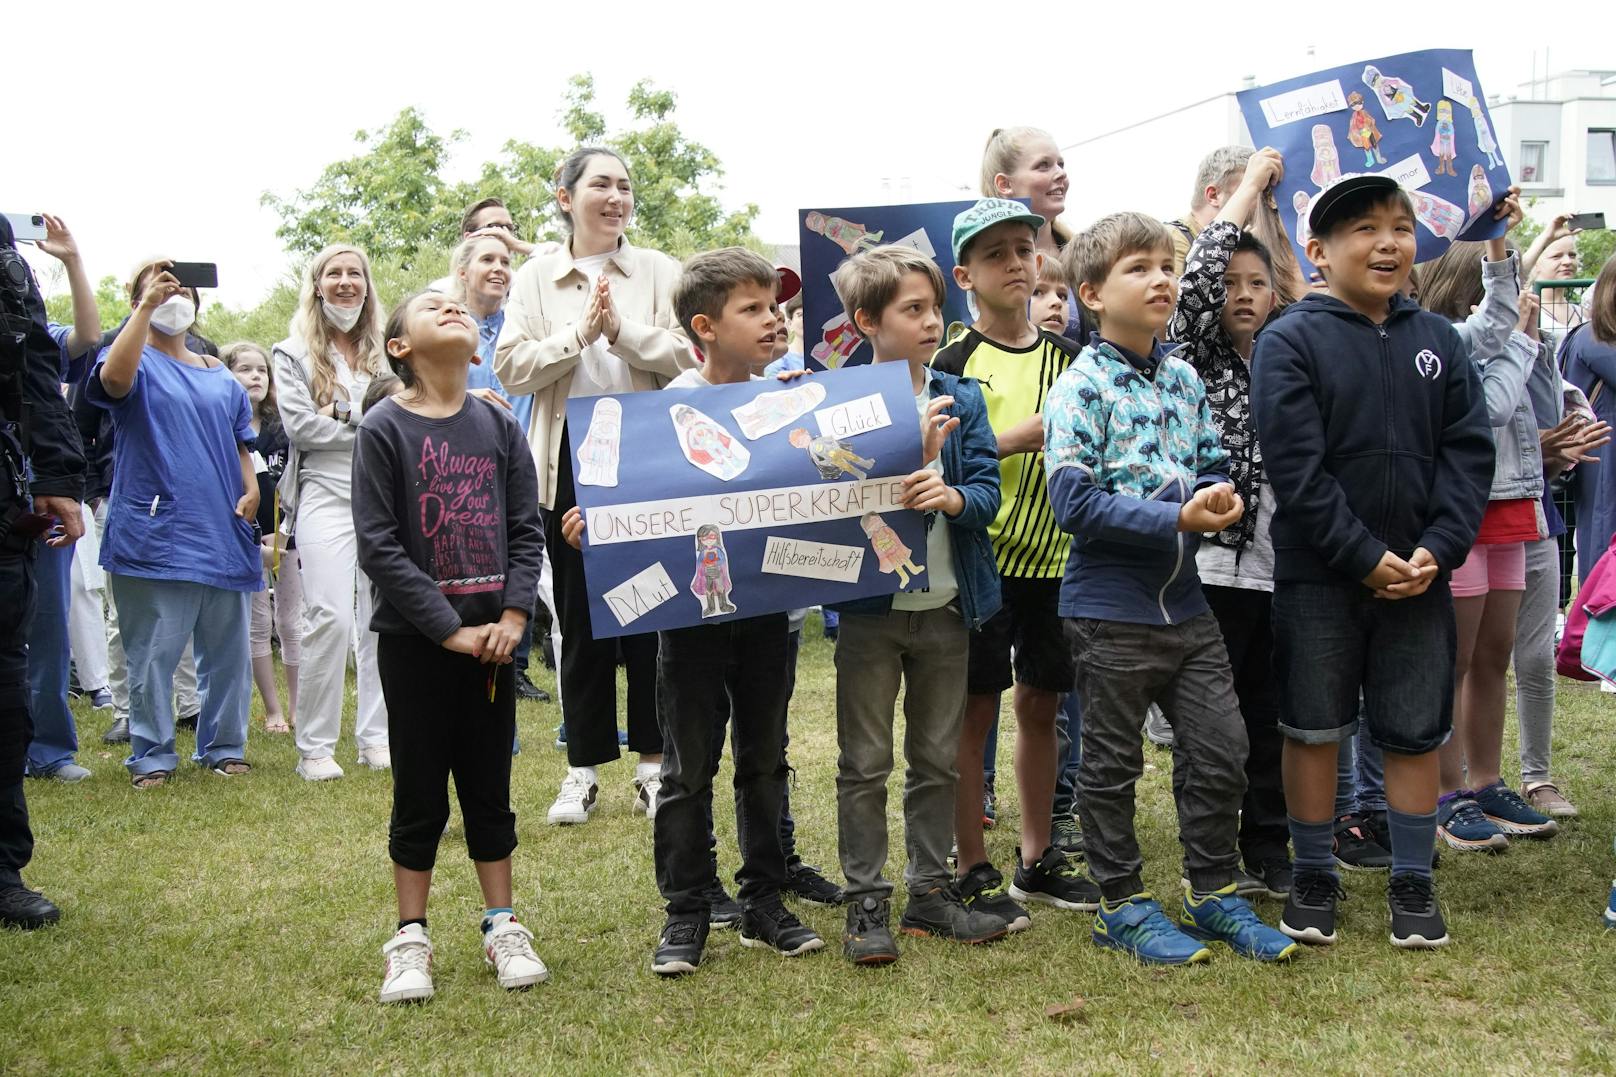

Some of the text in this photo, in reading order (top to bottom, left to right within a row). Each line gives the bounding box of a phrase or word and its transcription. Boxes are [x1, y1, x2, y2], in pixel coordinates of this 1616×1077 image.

[982, 210, 1014, 225] JUNGLE
[831, 399, 883, 437] Glück
[418, 436, 497, 489] Always
[429, 475, 455, 495] live
[593, 507, 696, 541] UNSERE
[766, 541, 862, 572] Hilfsbereitschaft
[608, 575, 673, 626] Mut
